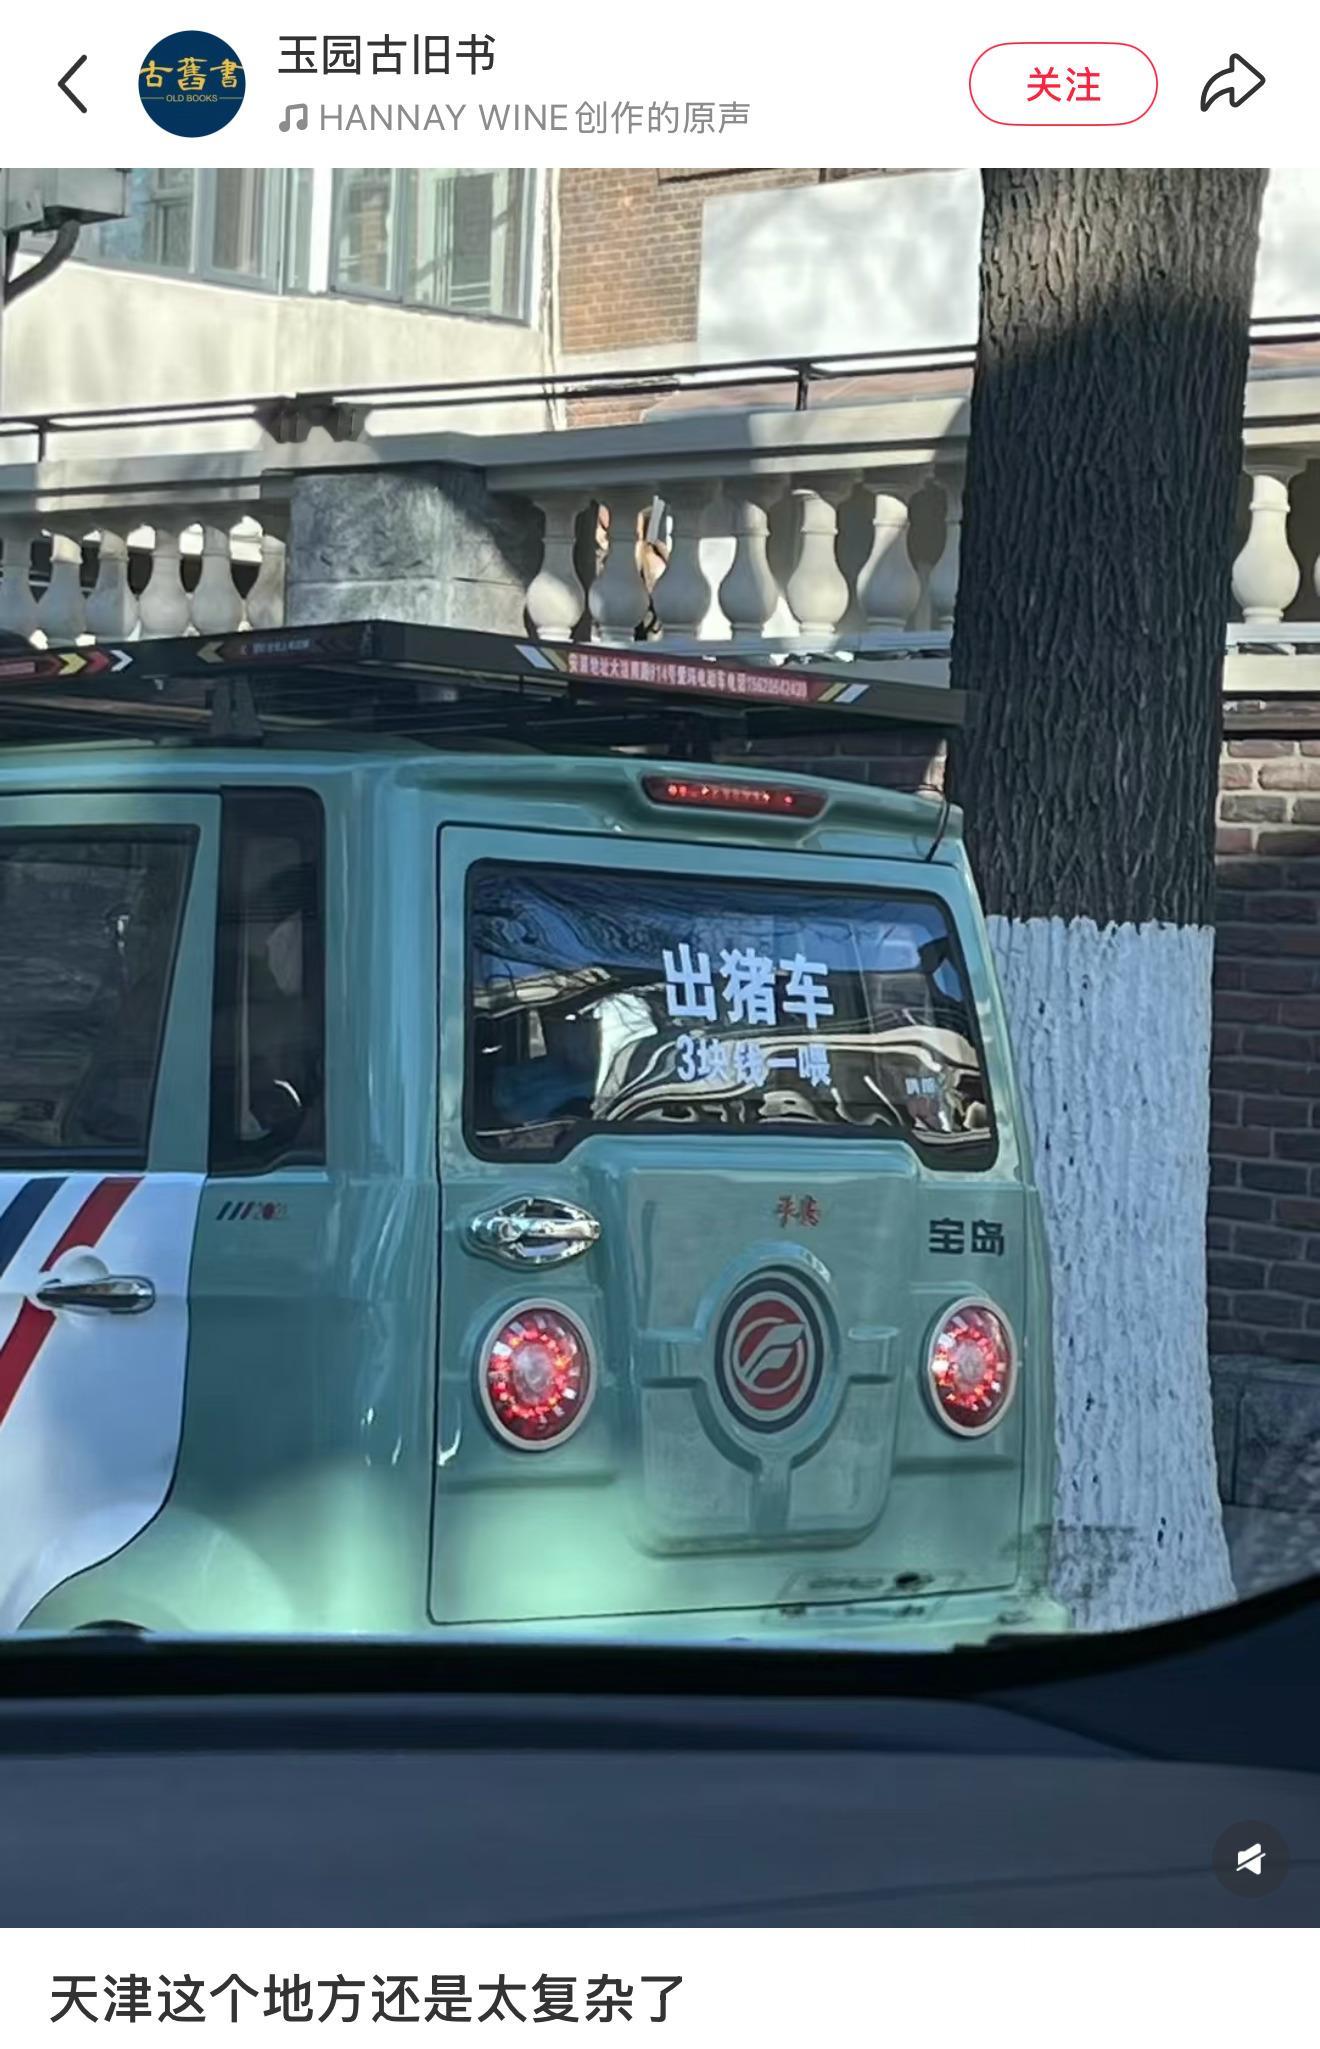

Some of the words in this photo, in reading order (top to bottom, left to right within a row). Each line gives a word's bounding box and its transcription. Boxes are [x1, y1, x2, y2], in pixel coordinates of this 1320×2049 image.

[662, 942, 834, 1029] 出猪车
[676, 1034, 831, 1088] 3块钱一喂
[928, 1218, 1005, 1256] 宝岛
